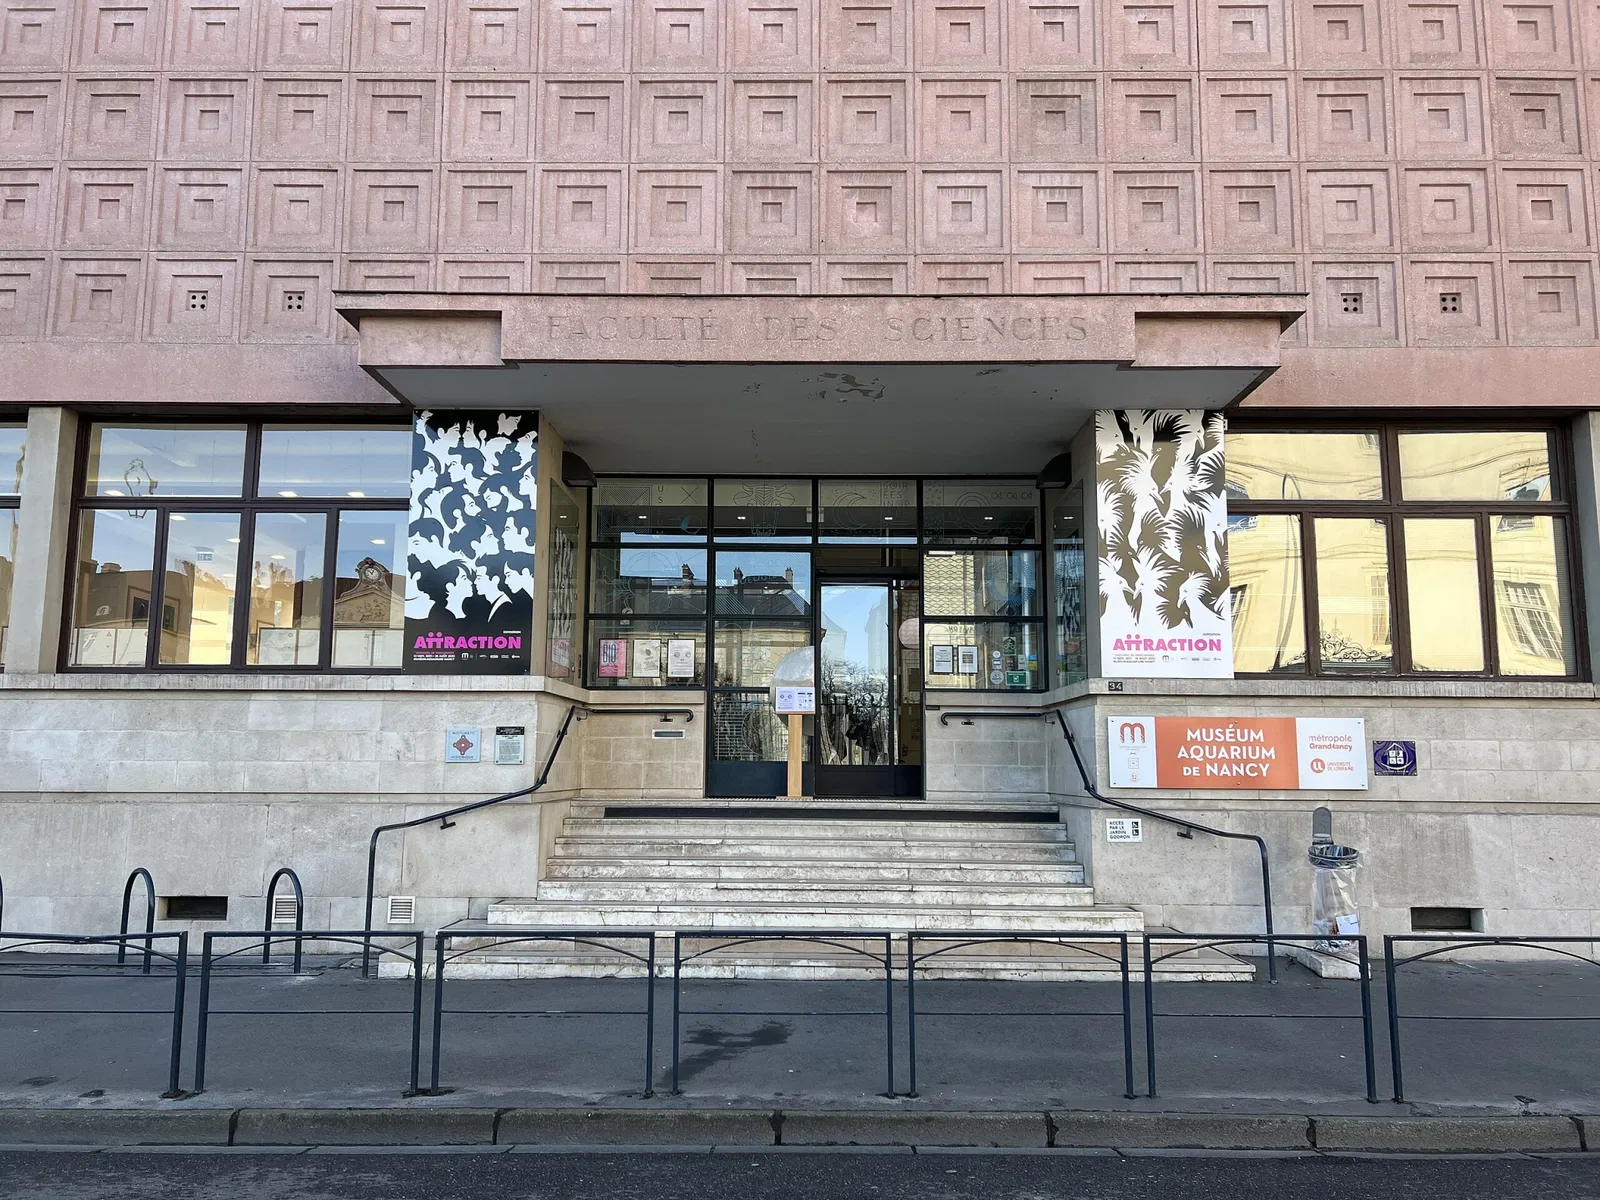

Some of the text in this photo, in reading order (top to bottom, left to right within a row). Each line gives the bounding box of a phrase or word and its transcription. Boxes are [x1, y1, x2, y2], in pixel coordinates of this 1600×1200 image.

[763, 316, 837, 341] DES
[884, 316, 1088, 342] SCIENCES
[413, 631, 522, 649] ATTRACTION
[1113, 634, 1222, 651] ATTRACTION
[1109, 682, 1122, 690] 34
[1186, 723, 1264, 742] MUSÉUM
[1309, 734, 1352, 743] métropole
[1177, 745, 1276, 761] AQUARIUM
[1183, 762, 1270, 777] DE NANCY
